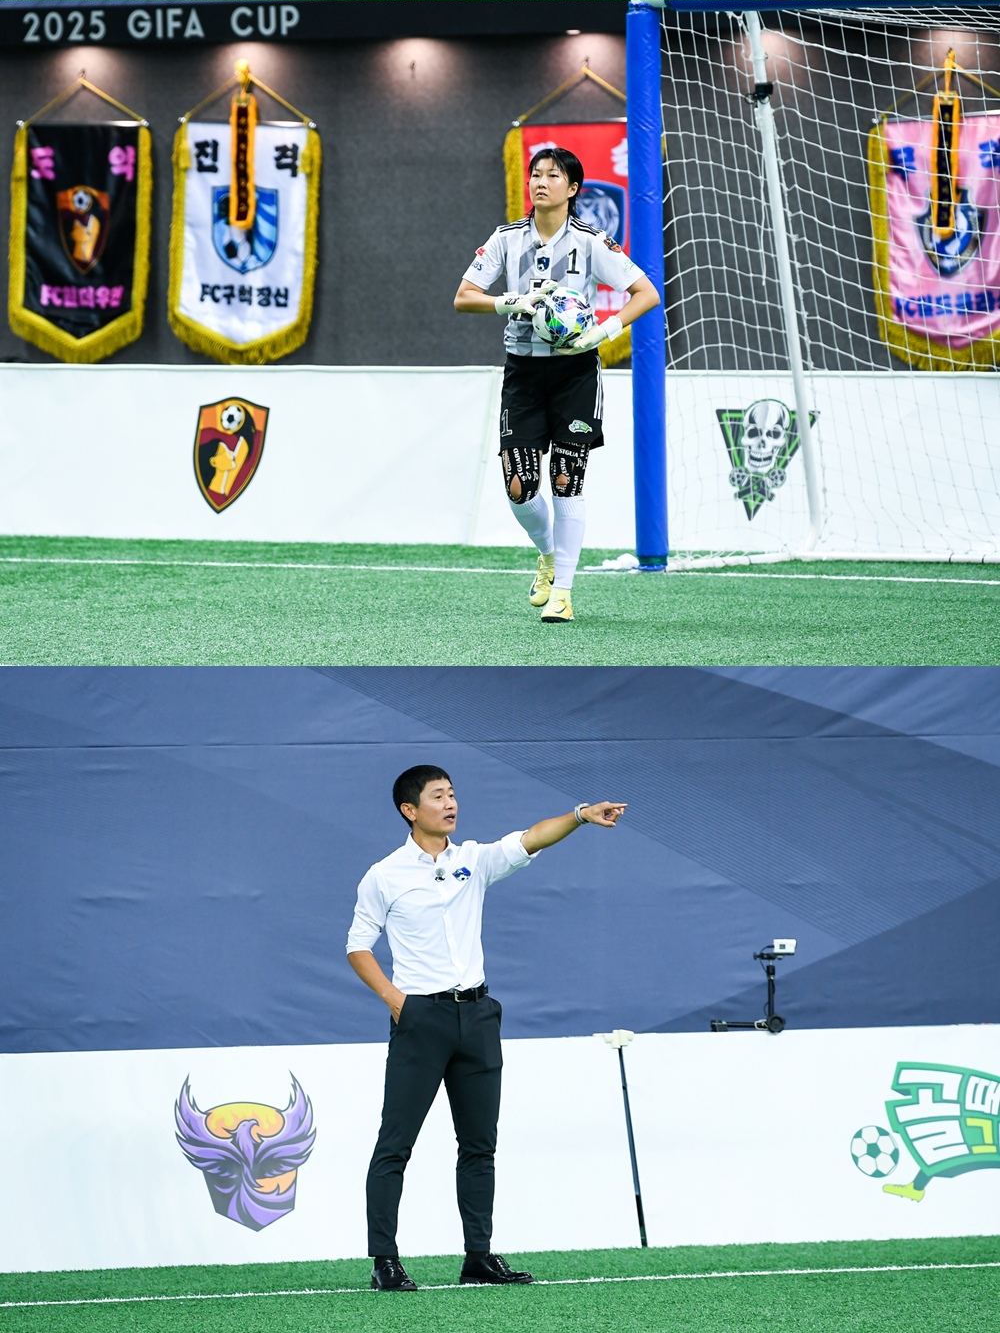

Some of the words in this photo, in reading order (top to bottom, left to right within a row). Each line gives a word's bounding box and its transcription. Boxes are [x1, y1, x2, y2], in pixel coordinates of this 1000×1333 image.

[23, 10, 106, 42] 2025
[127, 8, 205, 39] GIFA
[230, 5, 300, 36] CUP
[566, 248, 580, 275] 1
[501, 408, 513, 437] 1
